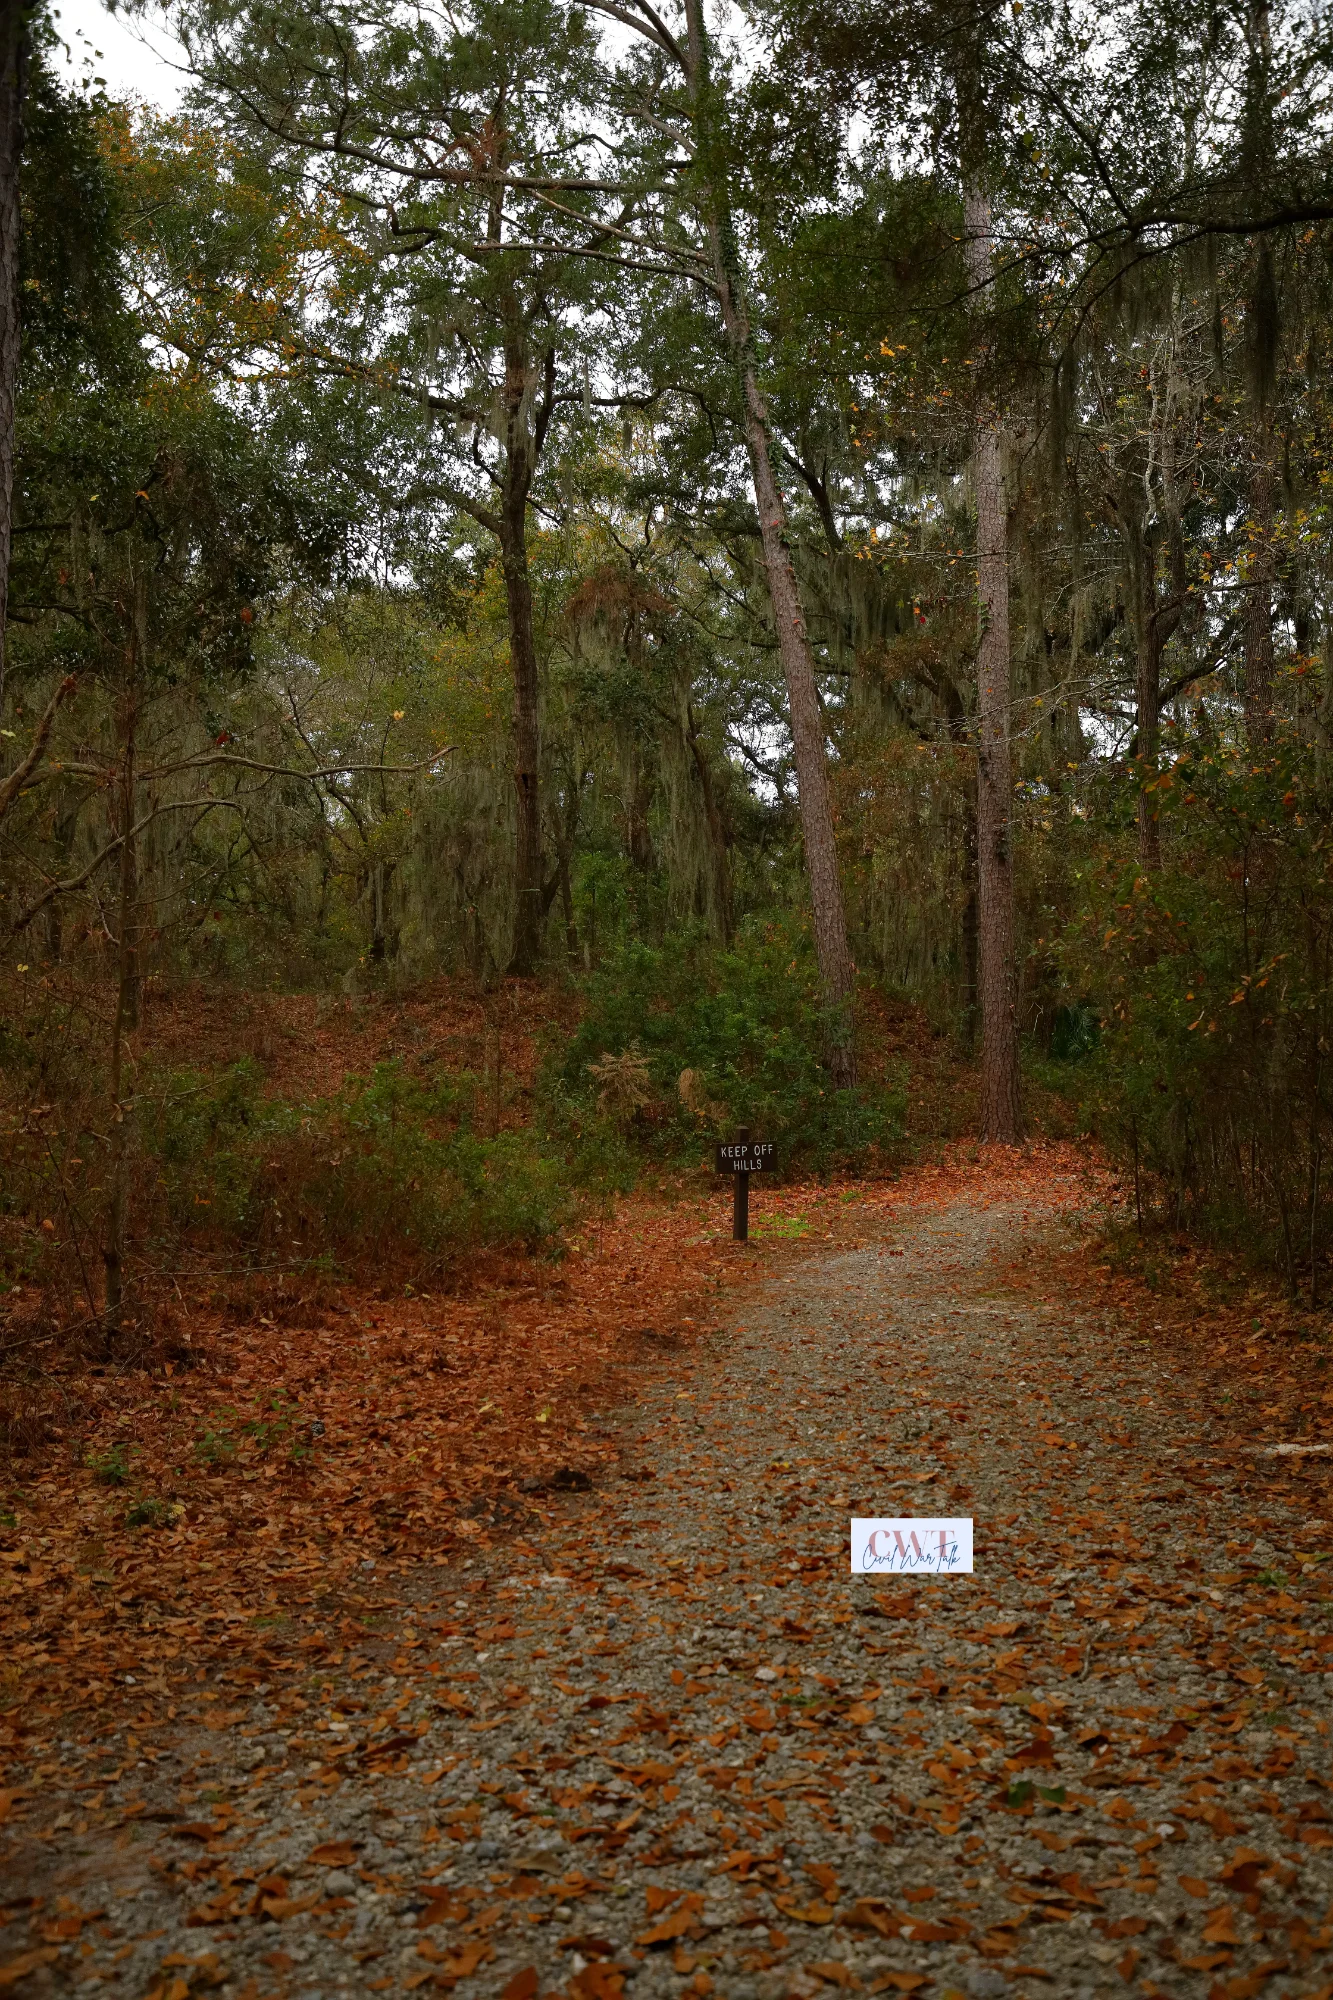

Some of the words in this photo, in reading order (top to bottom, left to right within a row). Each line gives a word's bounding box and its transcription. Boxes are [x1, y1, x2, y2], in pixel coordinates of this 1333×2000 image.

[721, 1146, 748, 1157] KEEP
[754, 1144, 773, 1156] OFF
[733, 1159, 762, 1171] HILLS
